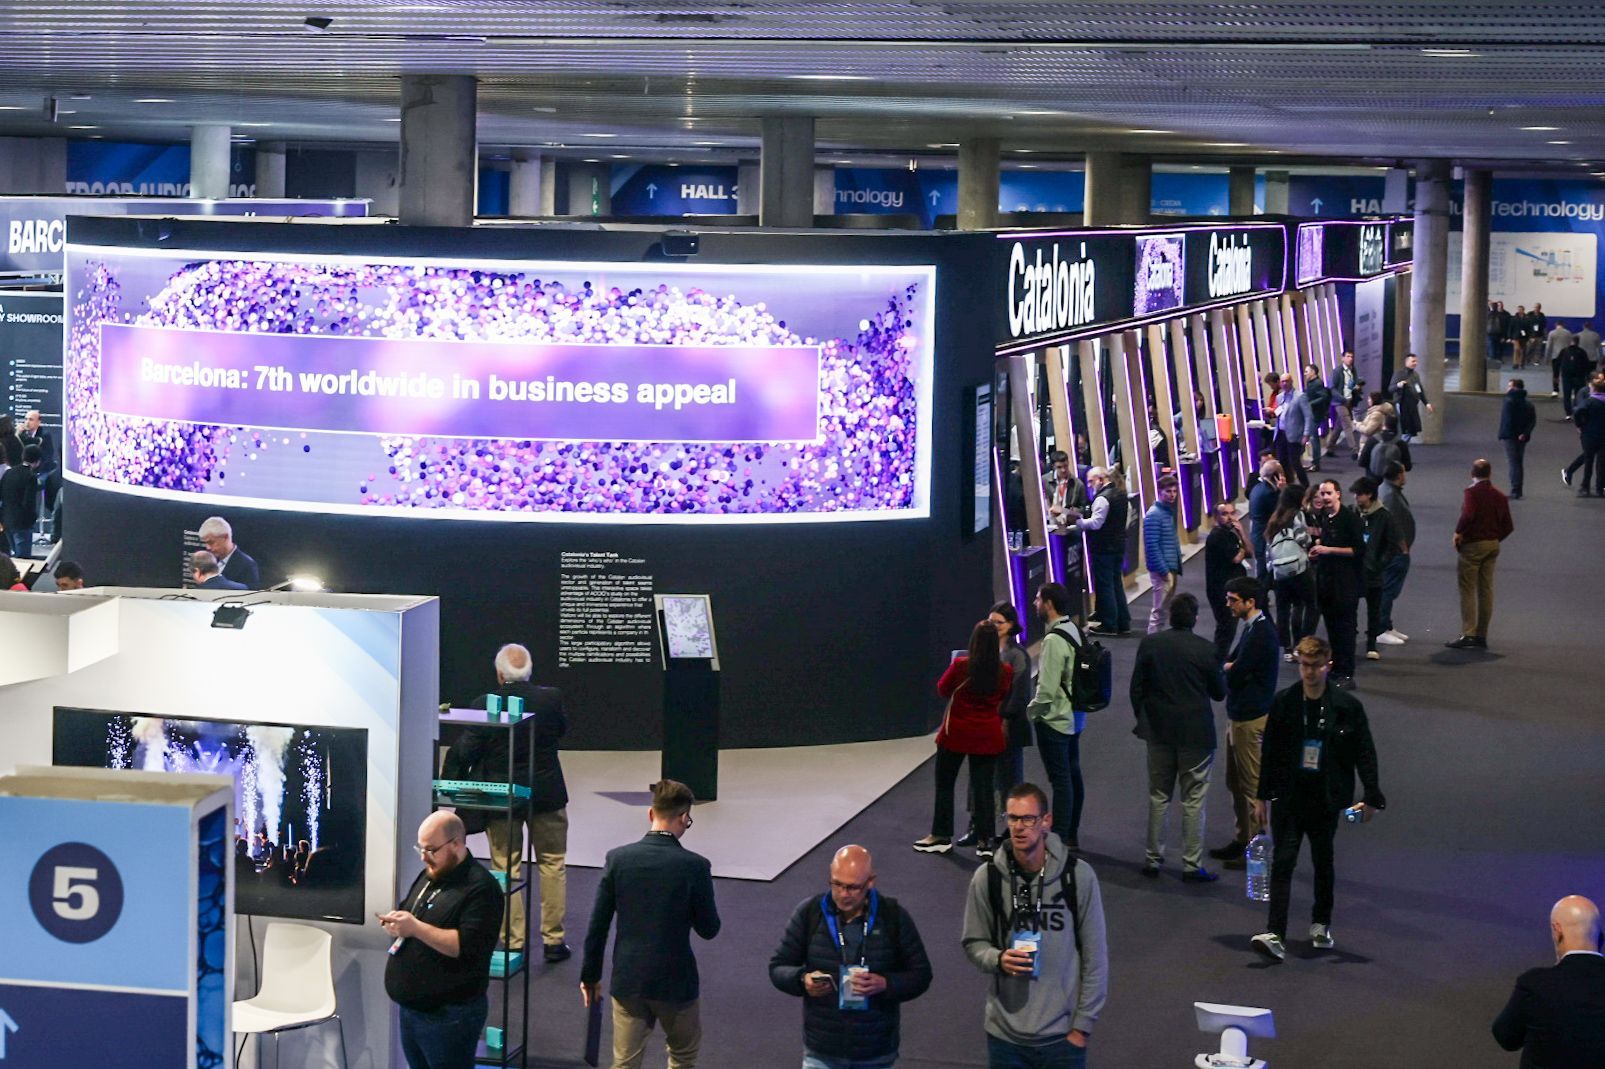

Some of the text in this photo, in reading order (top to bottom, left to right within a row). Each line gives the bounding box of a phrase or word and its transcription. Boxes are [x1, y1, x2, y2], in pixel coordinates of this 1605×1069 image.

[681, 184, 729, 200] HALL
[1490, 201, 1605, 221] Technology
[9, 219, 66, 254] BARC
[1008, 242, 1095, 337] Catalonia
[1208, 232, 1251, 298] Catalonia
[140, 356, 738, 411] Barcelona: 7th worldwide in business appeal
[52, 865, 100, 920] 5
